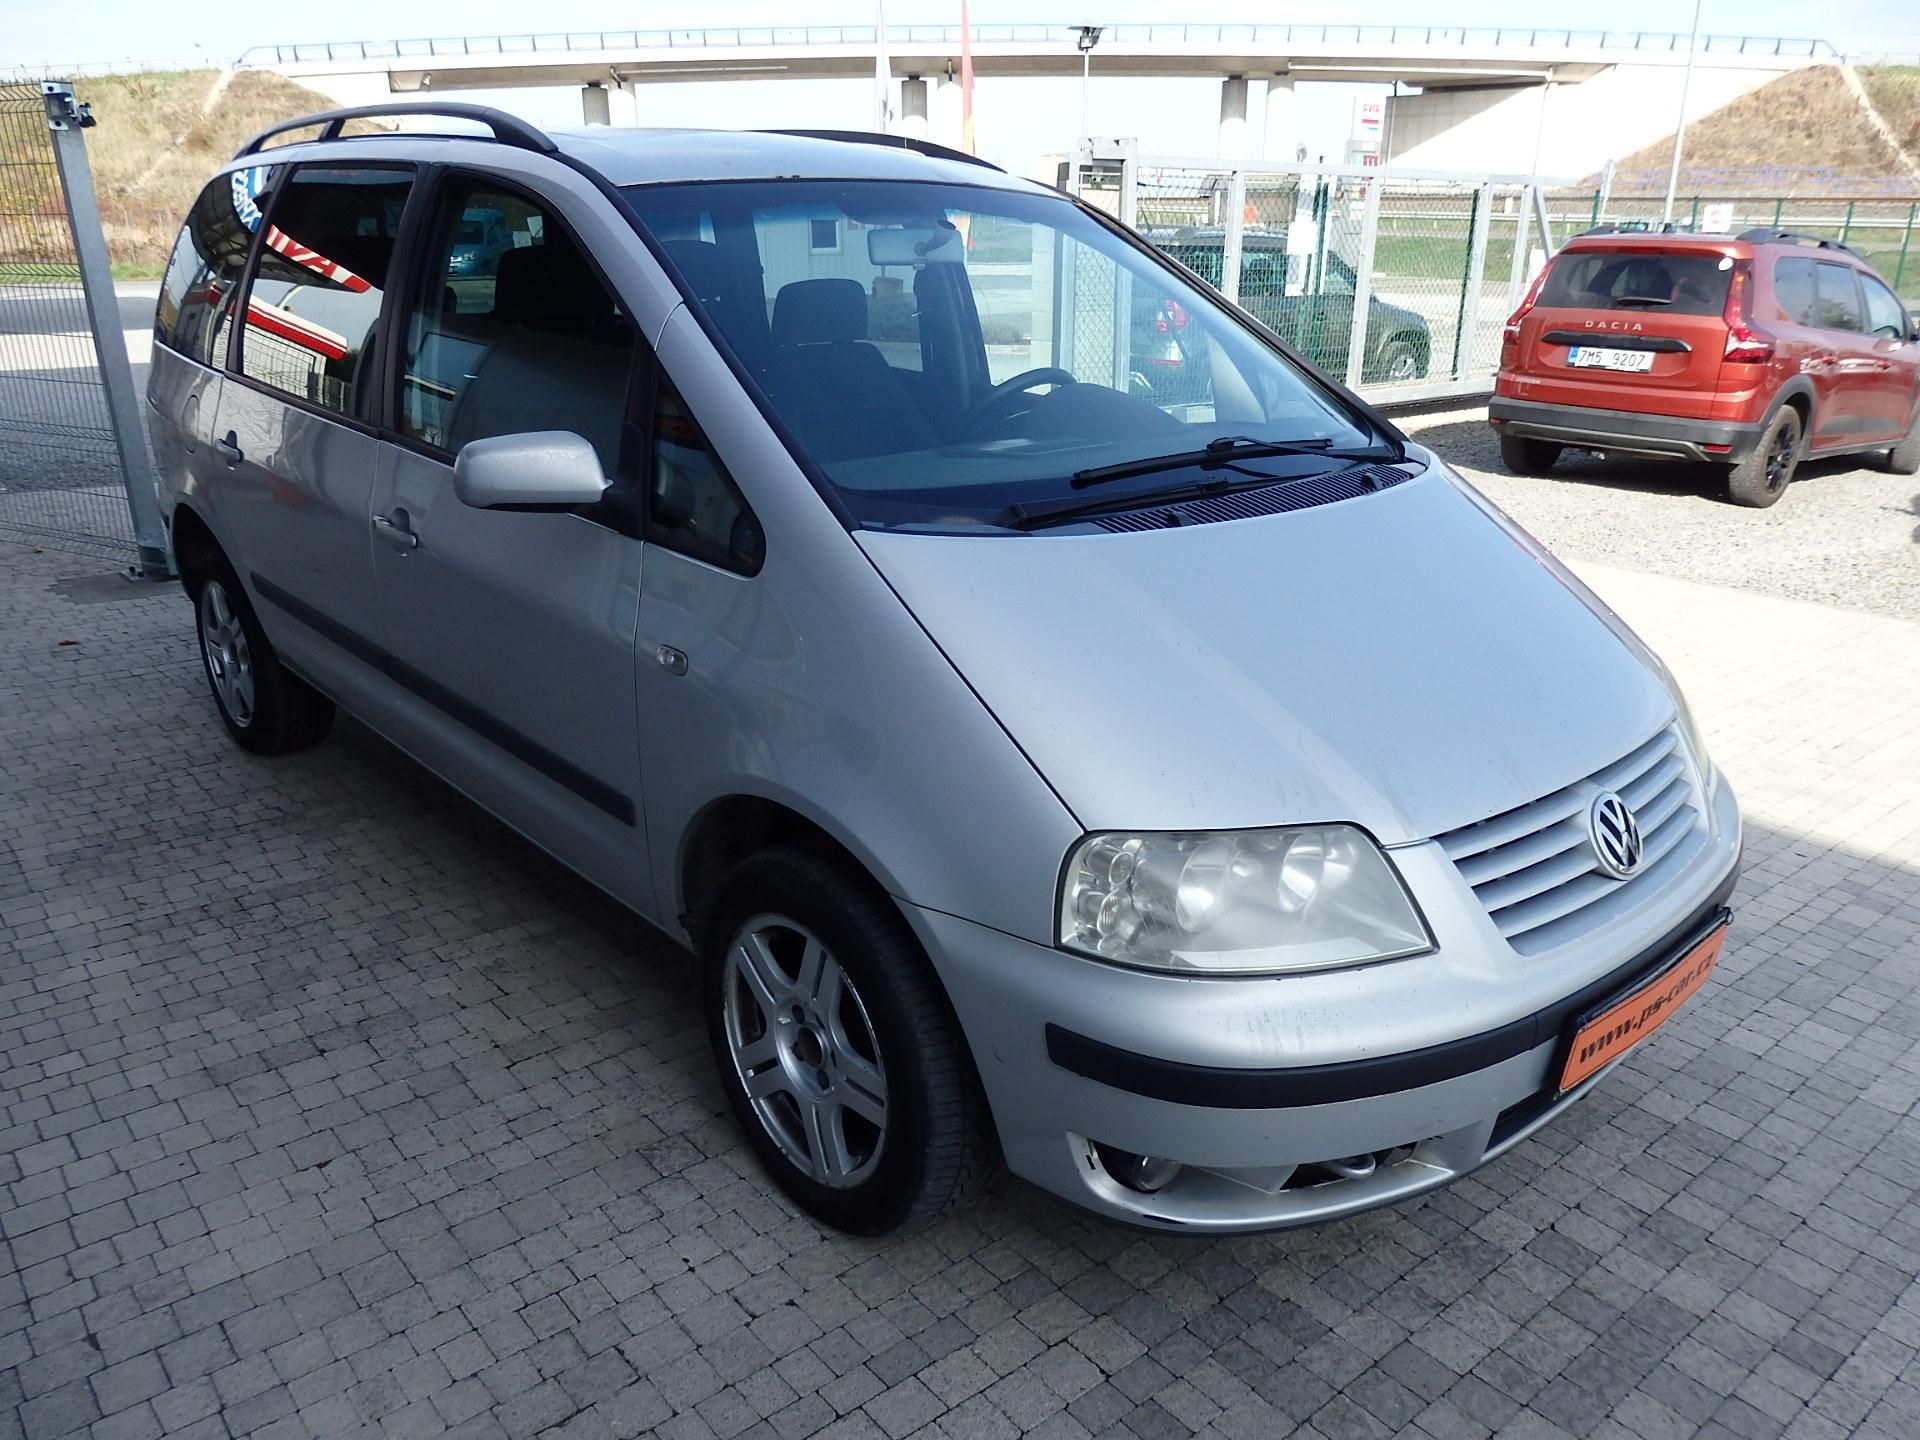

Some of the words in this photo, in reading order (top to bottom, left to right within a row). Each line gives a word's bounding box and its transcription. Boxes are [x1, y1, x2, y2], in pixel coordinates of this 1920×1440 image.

[1585, 320, 1642, 331] DACIA
[1579, 350, 1603, 364] 7M5
[1612, 352, 1646, 368] 9207
[1579, 952, 1716, 1064] www.ps-car.cz
